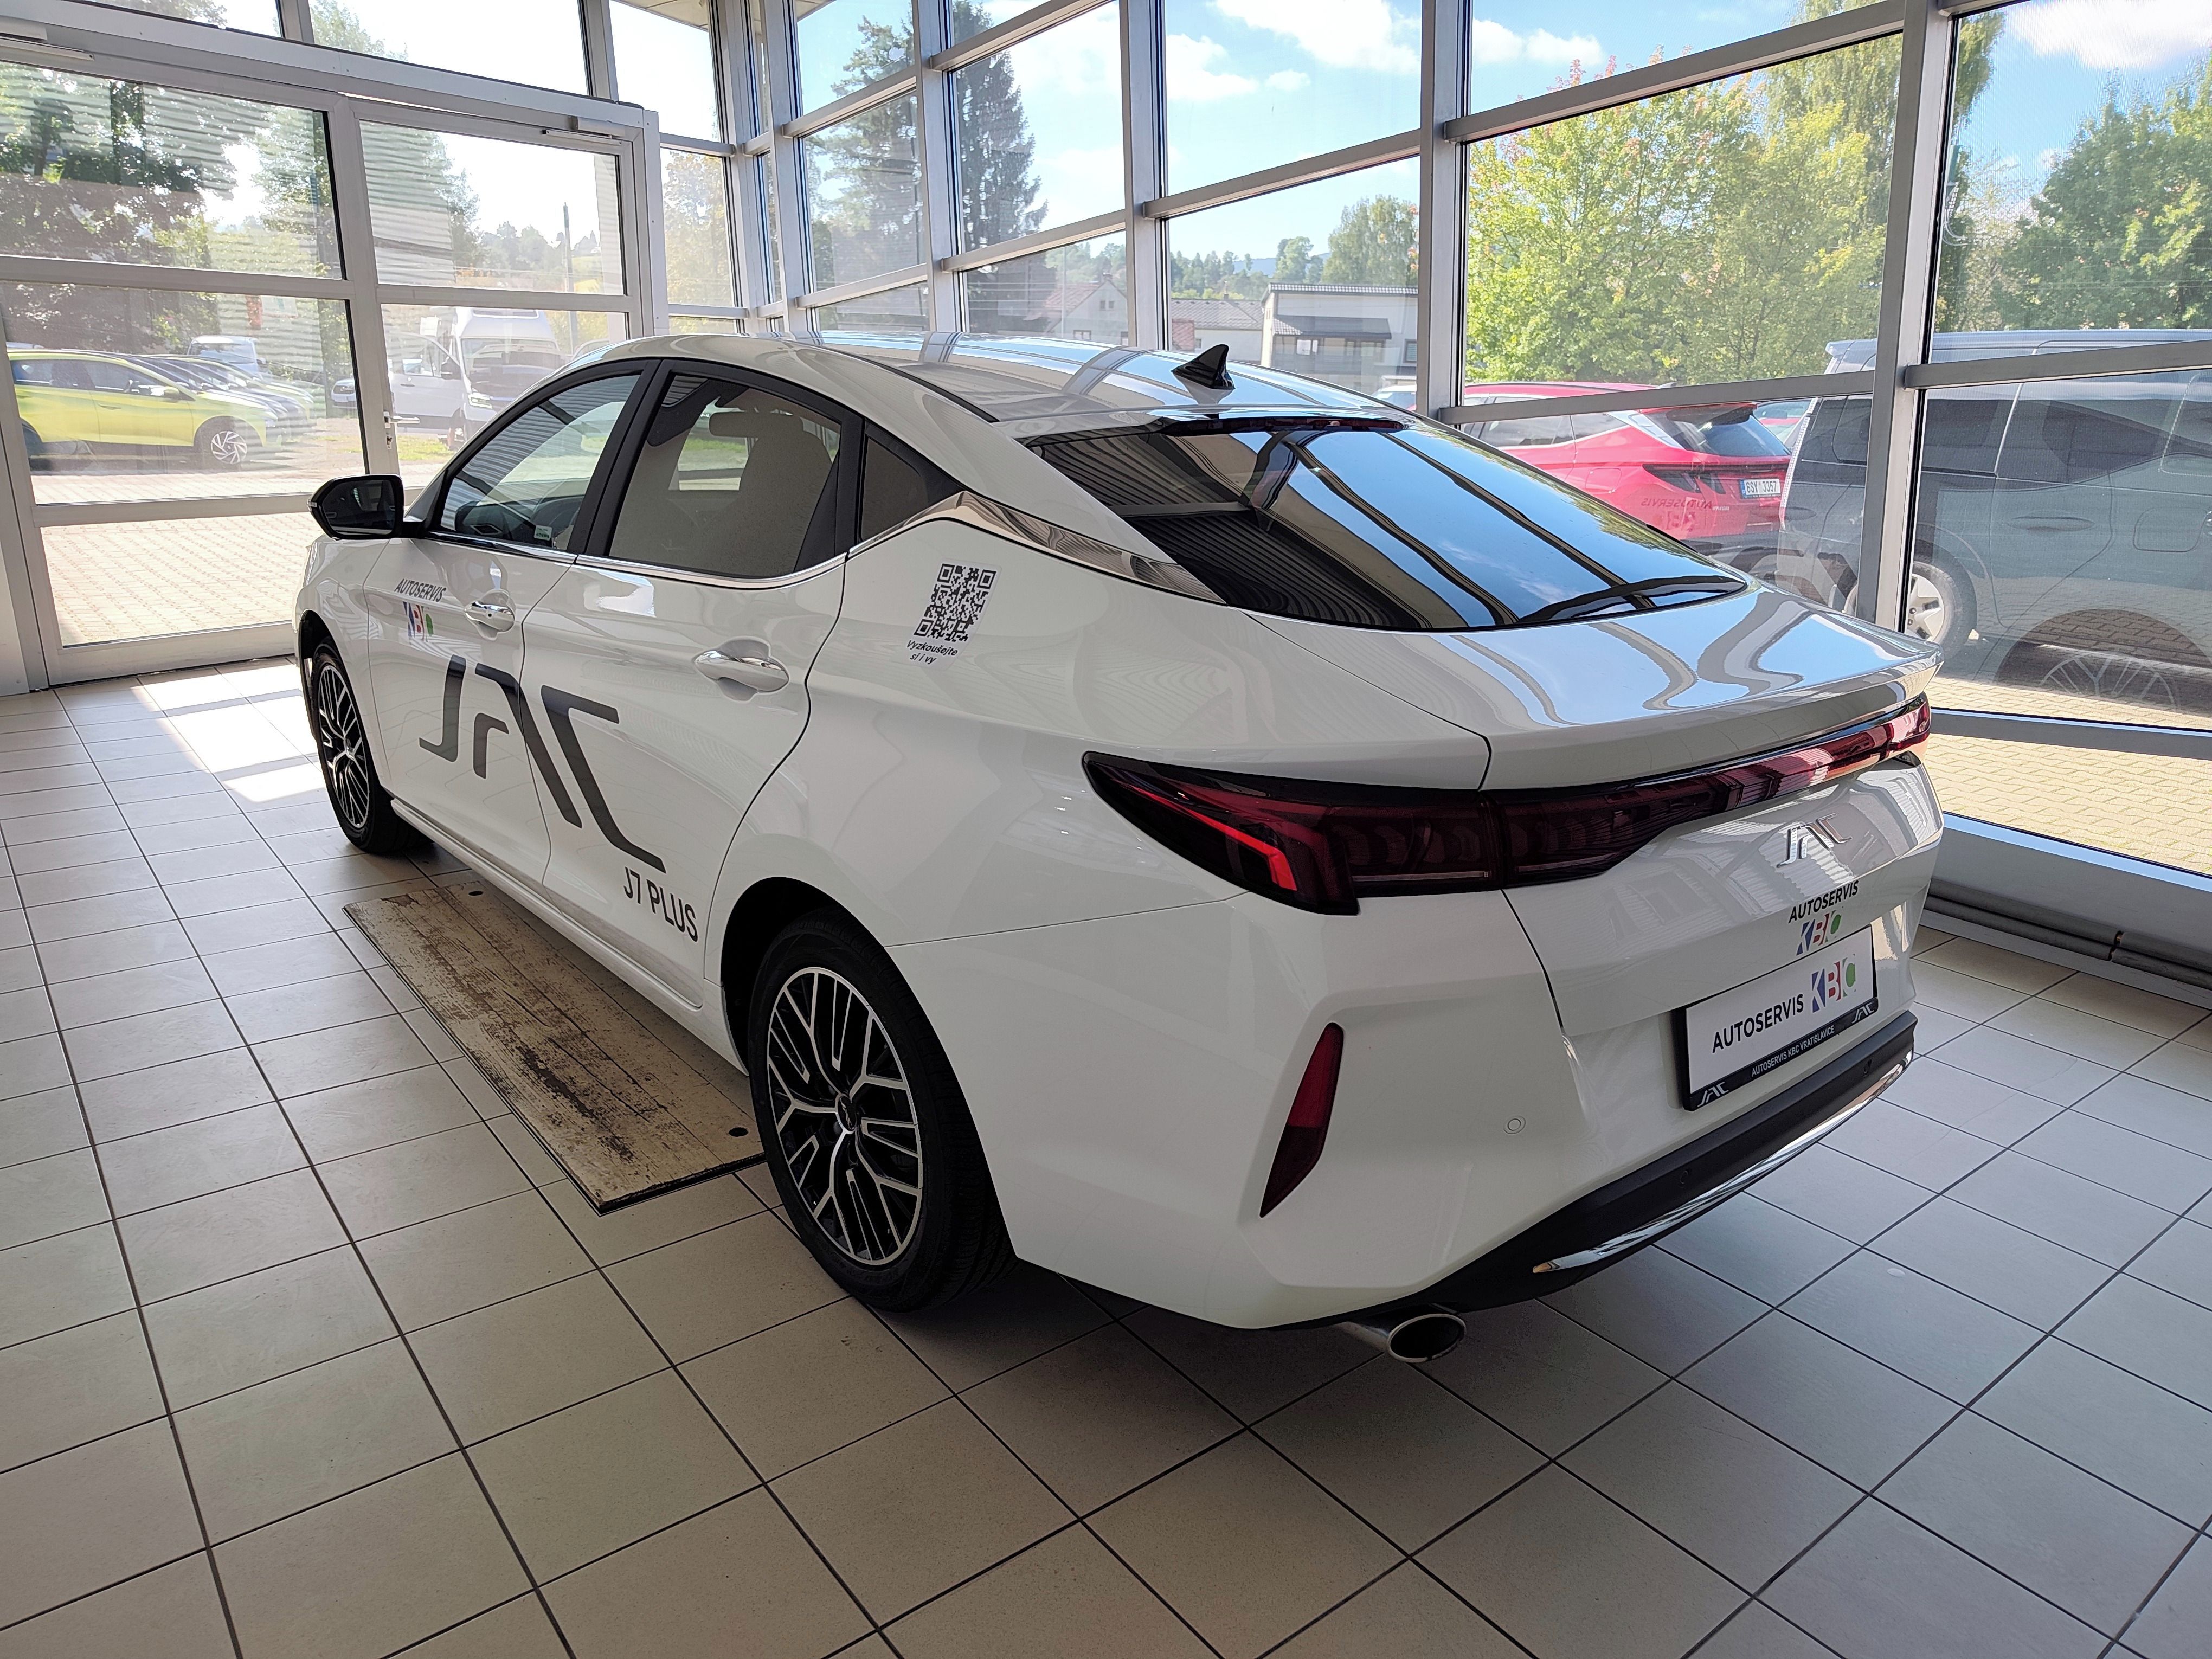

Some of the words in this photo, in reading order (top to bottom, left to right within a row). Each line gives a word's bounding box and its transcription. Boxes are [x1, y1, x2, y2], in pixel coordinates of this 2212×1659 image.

[1746, 481, 1758, 493] 6SV
[1763, 480, 1777, 492] 3357
[394, 578, 447, 602] AUTOSERVIS
[906, 640, 958, 656] Vyzkoušejte
[910, 653, 921, 661] si
[918, 653, 925, 661] i
[924, 656, 937, 665] vy
[623, 866, 642, 905] J7
[647, 879, 698, 942] PLUS
[1788, 880, 1859, 924] AUTOSERVIS
[1712, 993, 1804, 1053] AUTOSERVIS
[1752, 1052, 1787, 1077] AUTOSERVIS
[1787, 1044, 1799, 1058] KBC
[1800, 1025, 1835, 1051] VRATISLAVICE
